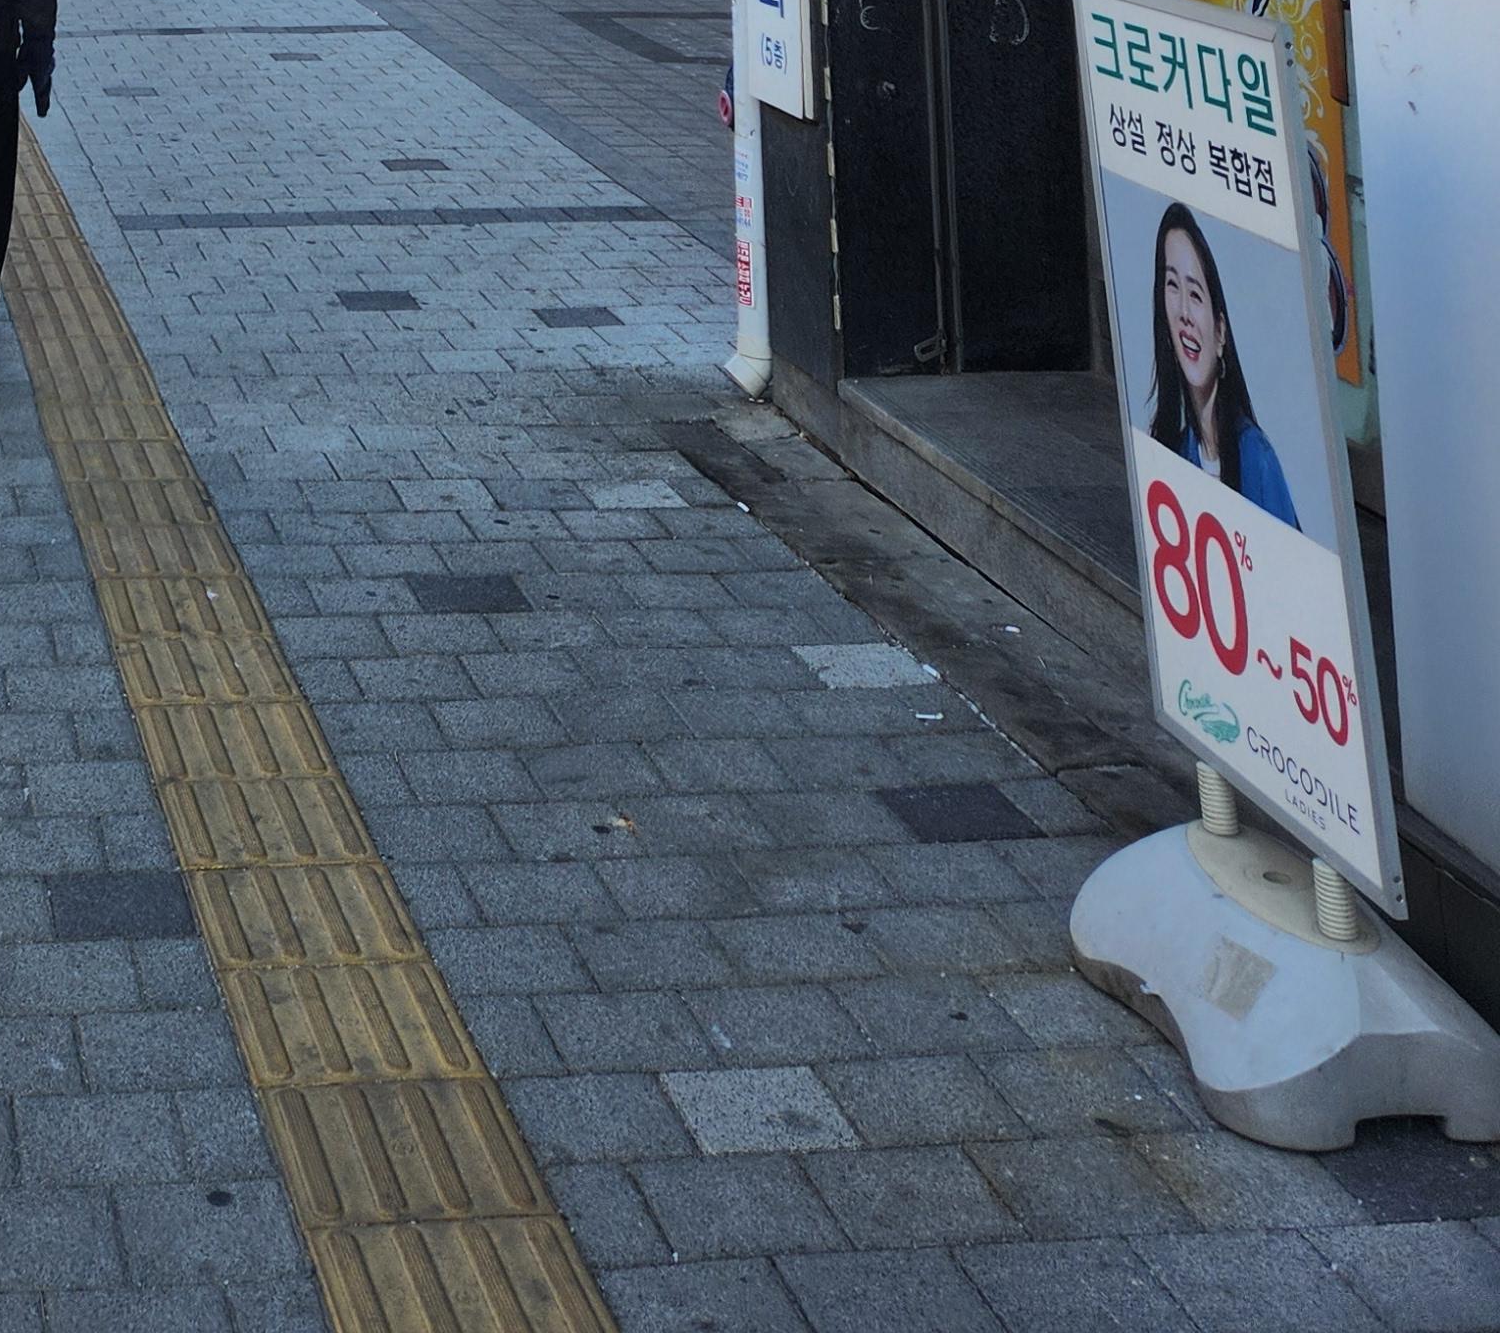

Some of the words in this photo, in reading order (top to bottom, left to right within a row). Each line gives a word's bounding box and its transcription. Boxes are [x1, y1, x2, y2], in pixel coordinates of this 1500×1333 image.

[1091, 10, 1279, 138] 크로커다일
[1108, 101, 1147, 160] 상설
[1156, 123, 1197, 177] 정상
[1207, 138, 1278, 208] 복합점
[1247, 726, 1360, 835] CROCODILE
[1285, 789, 1326, 831] LADIES
